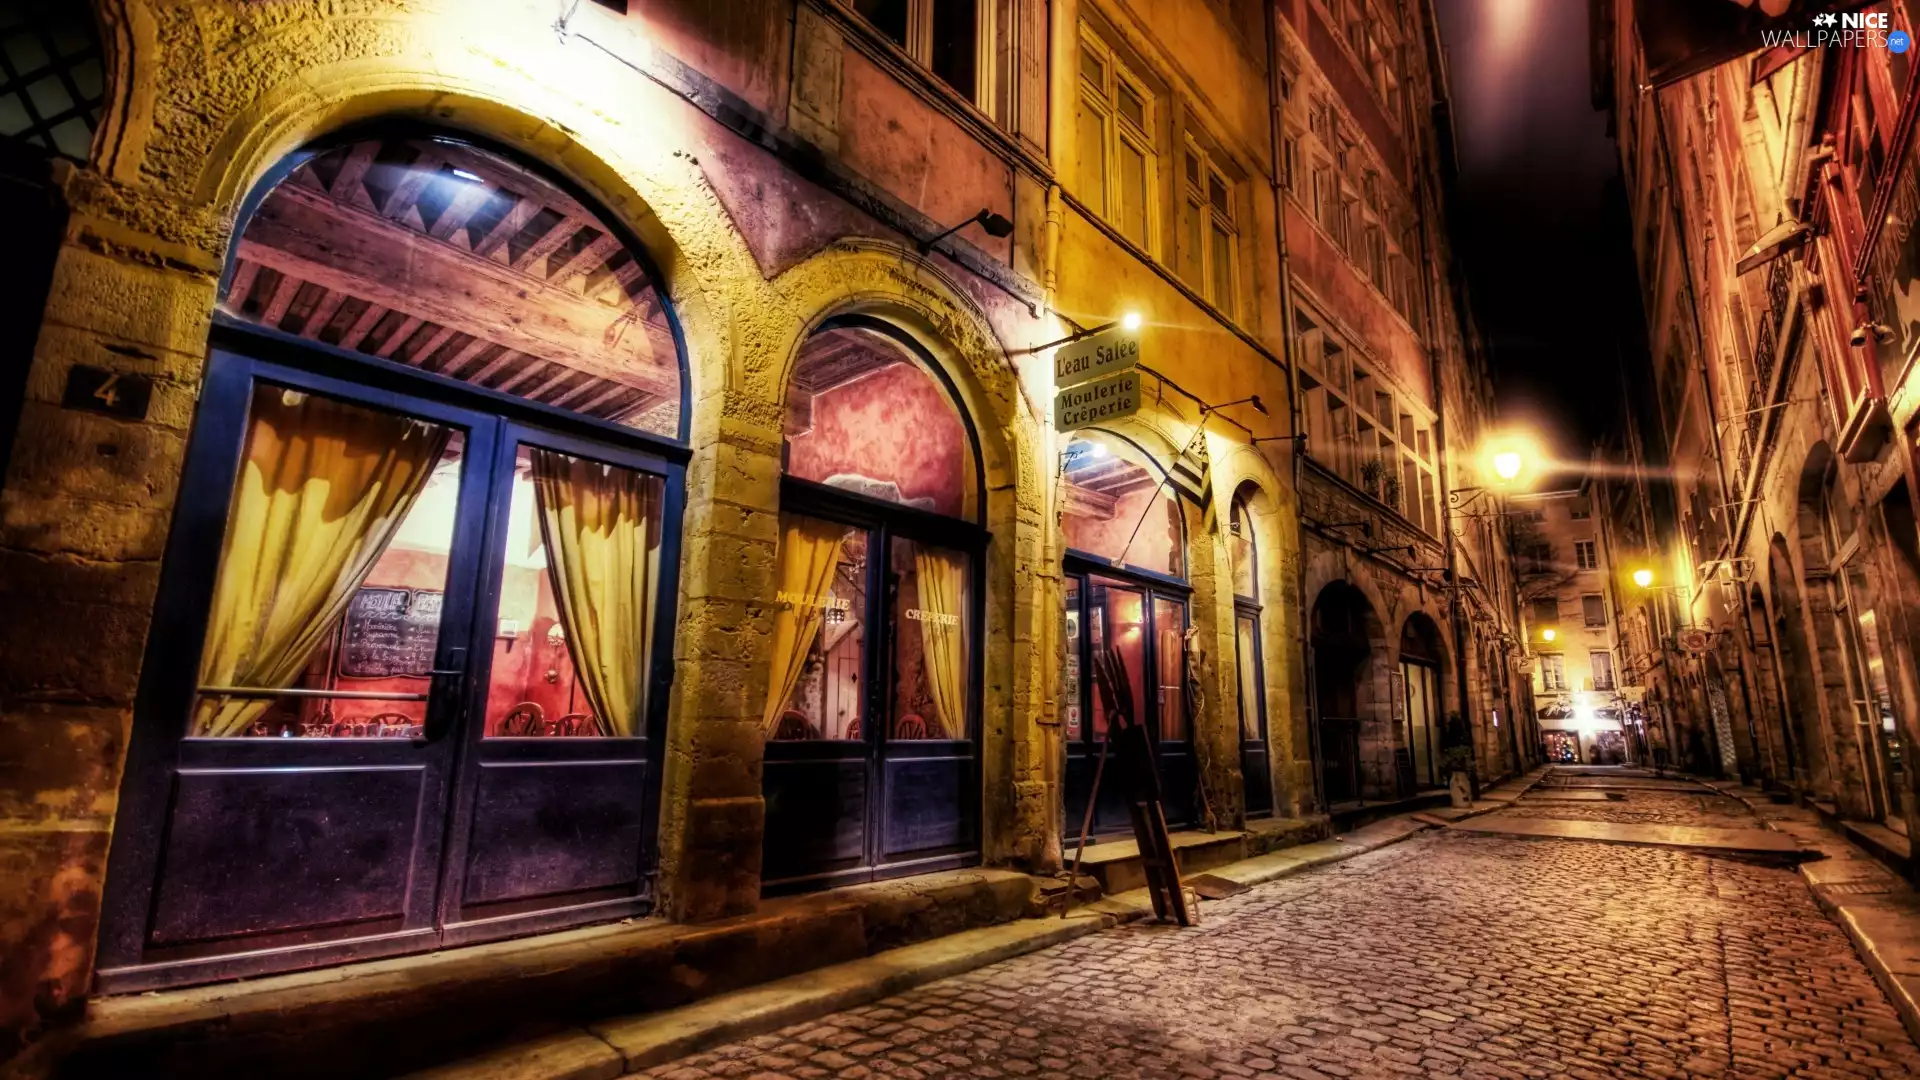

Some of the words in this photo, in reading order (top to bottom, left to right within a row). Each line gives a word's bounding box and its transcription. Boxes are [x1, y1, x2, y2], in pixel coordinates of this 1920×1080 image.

[1057, 355, 1090, 378] L'eau
[1096, 339, 1136, 366] Salée
[94, 373, 120, 407] 4
[1061, 379, 1133, 410] Moulerie
[1063, 397, 1132, 426] Crêperie
